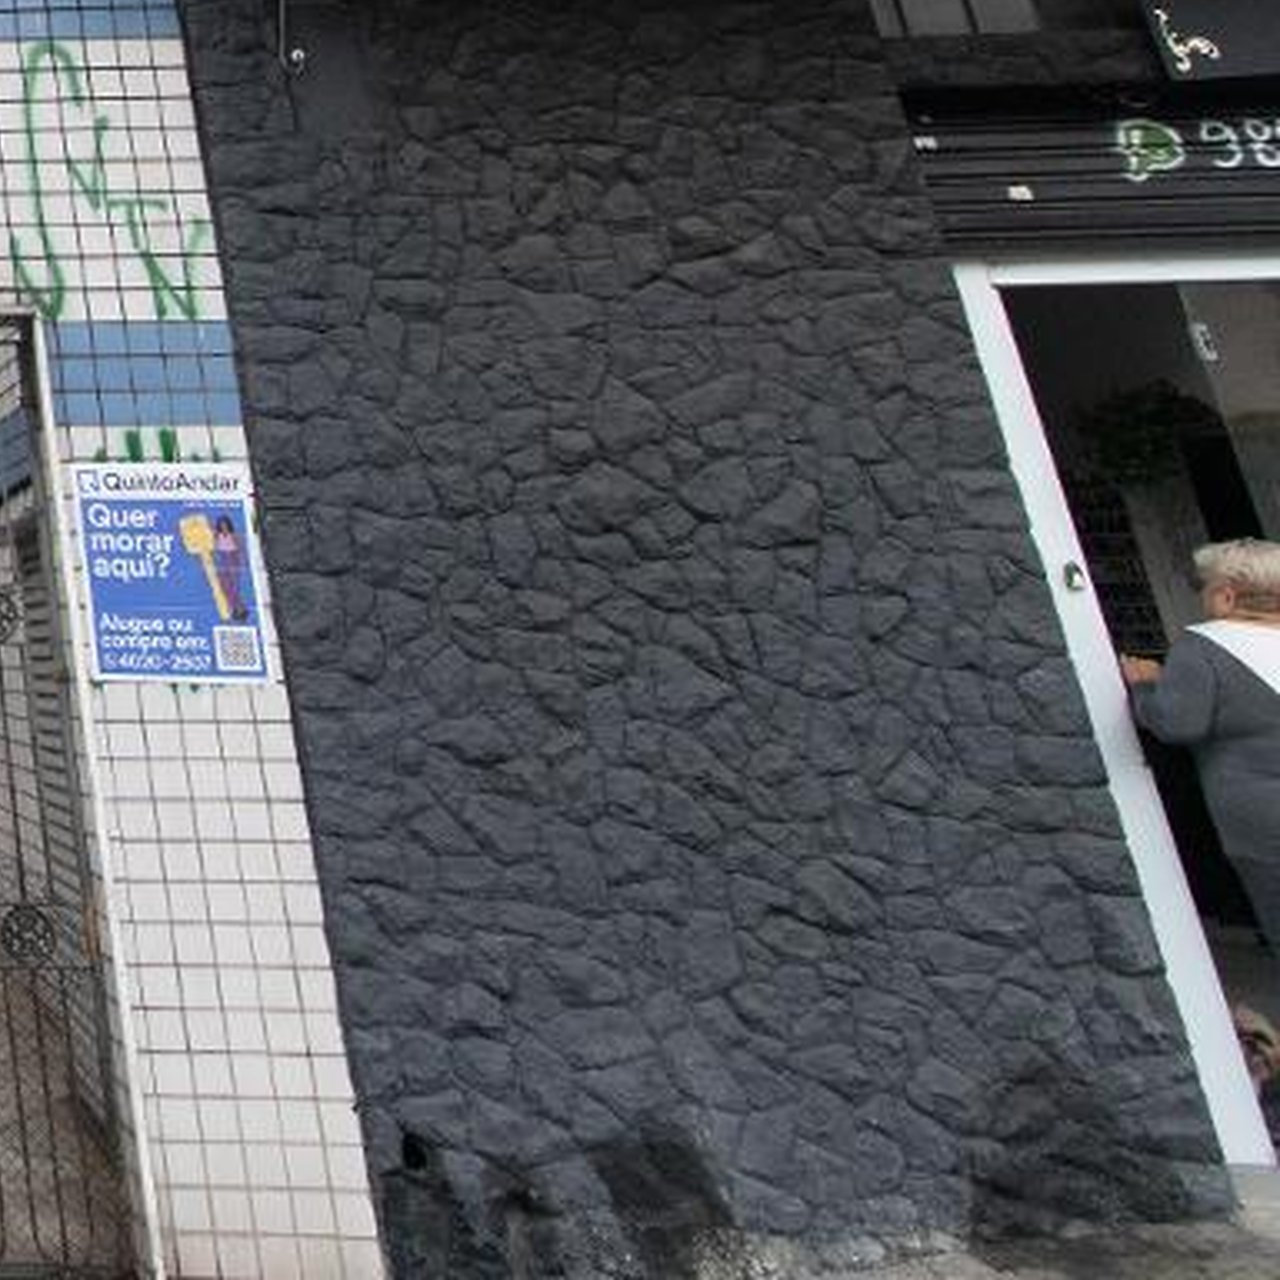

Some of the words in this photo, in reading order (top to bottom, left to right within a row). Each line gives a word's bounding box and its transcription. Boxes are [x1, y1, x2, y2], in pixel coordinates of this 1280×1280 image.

[102, 472, 240, 492] QuintoAndar
[88, 502, 158, 528] Quer
[91, 532, 175, 553] morar
[93, 552, 171, 582] aqui?
